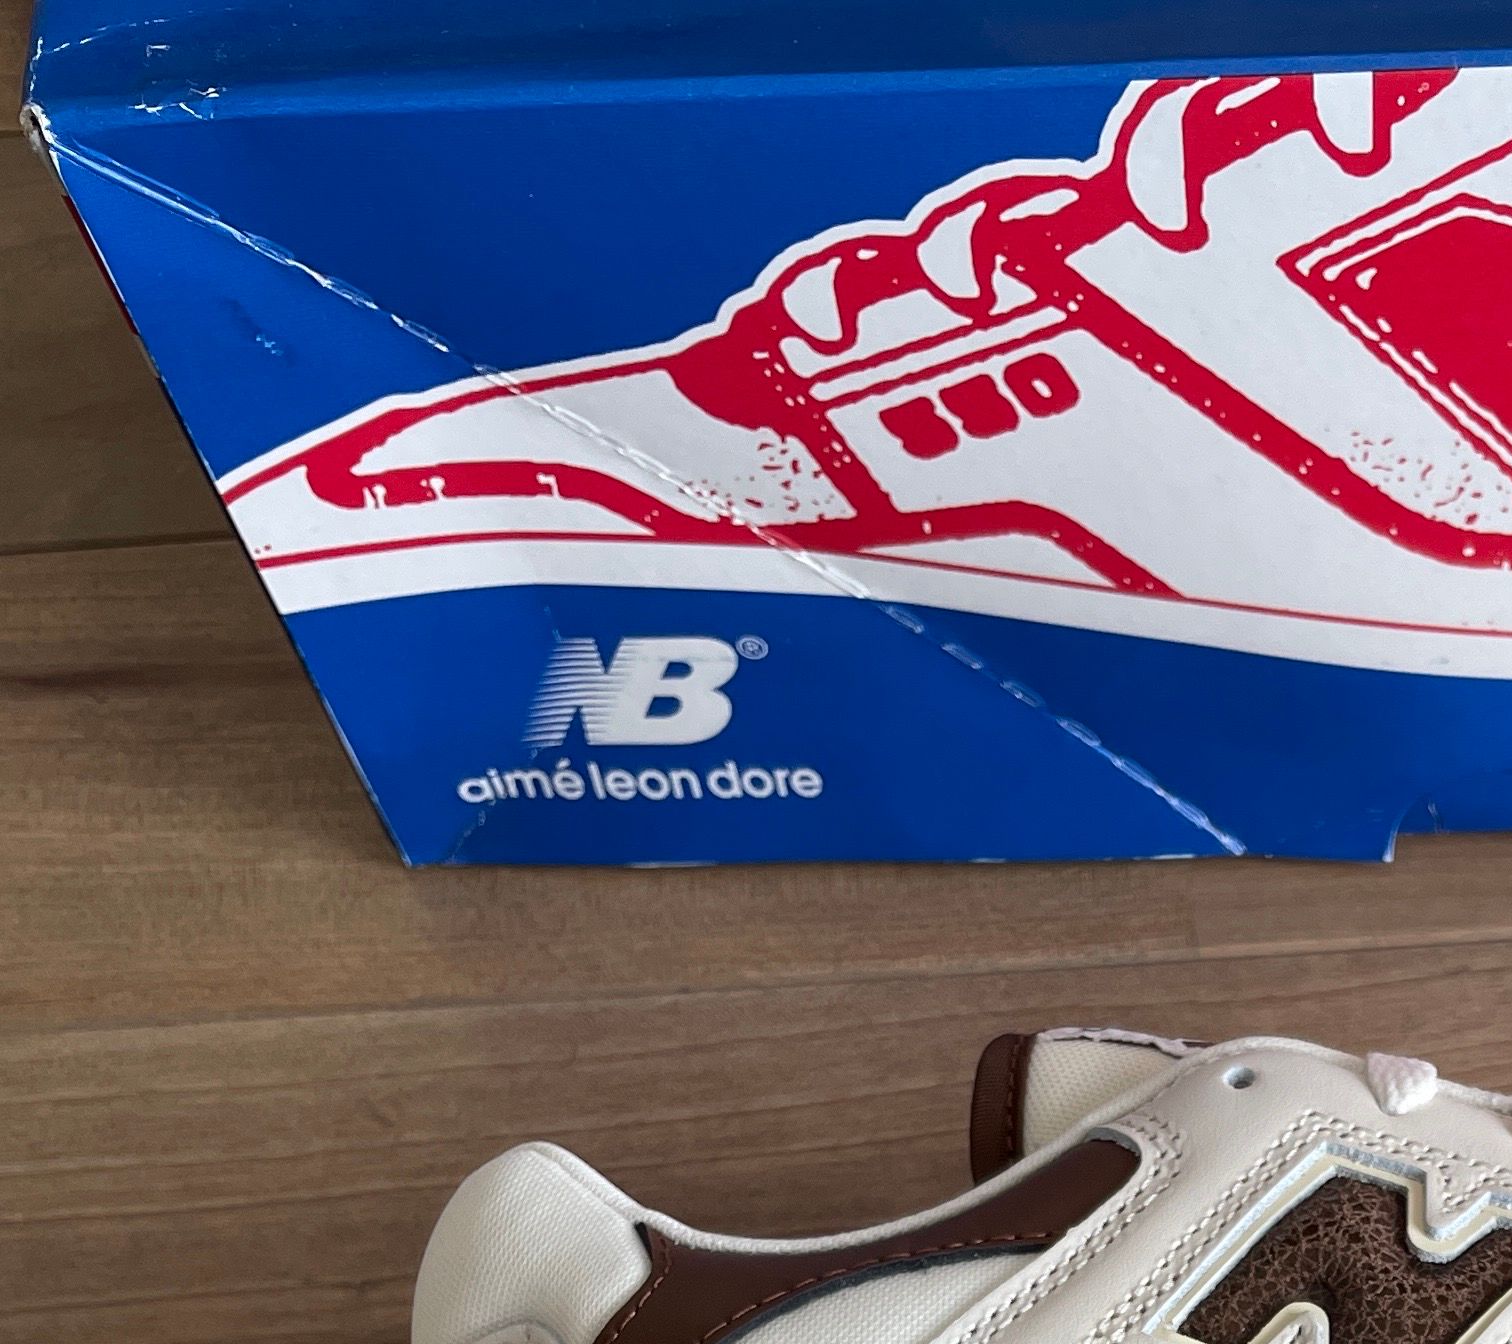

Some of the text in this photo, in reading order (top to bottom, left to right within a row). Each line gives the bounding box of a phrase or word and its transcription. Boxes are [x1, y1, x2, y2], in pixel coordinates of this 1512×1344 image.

[457, 758, 824, 804] aimé leon dore
